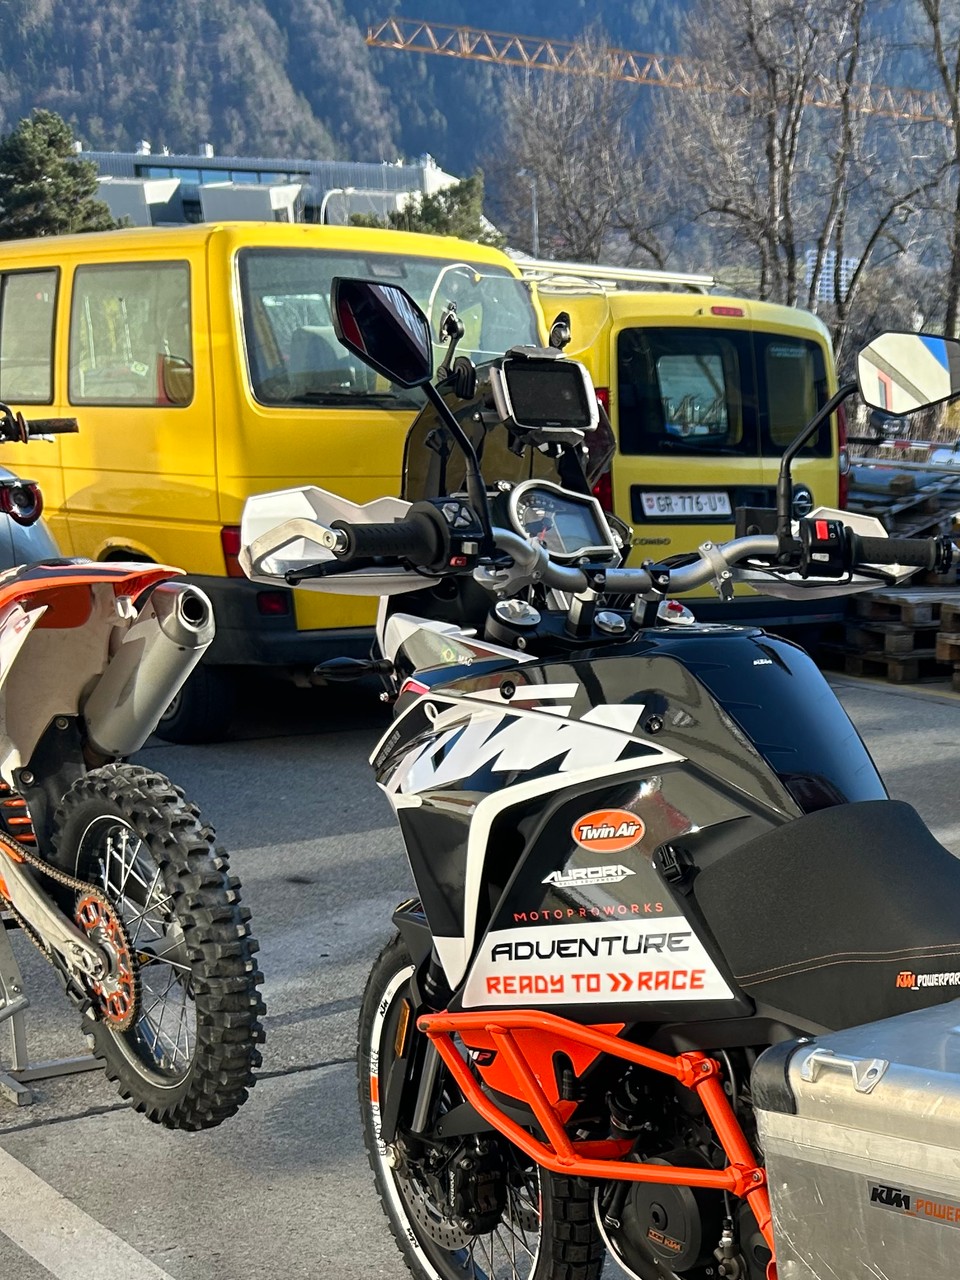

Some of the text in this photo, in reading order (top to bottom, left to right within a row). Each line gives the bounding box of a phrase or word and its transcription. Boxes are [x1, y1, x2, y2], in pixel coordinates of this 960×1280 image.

[458, 654, 473, 666] MAC
[579, 822, 641, 841] Twin Air
[541, 864, 637, 884] AURORA
[513, 902, 664, 922] MOTOPROWORKS
[491, 931, 692, 962] ADVENTURE
[486, 969, 706, 994] READY TO RACE
[896, 971, 916, 988] KTM
[871, 1185, 911, 1211] KTM
